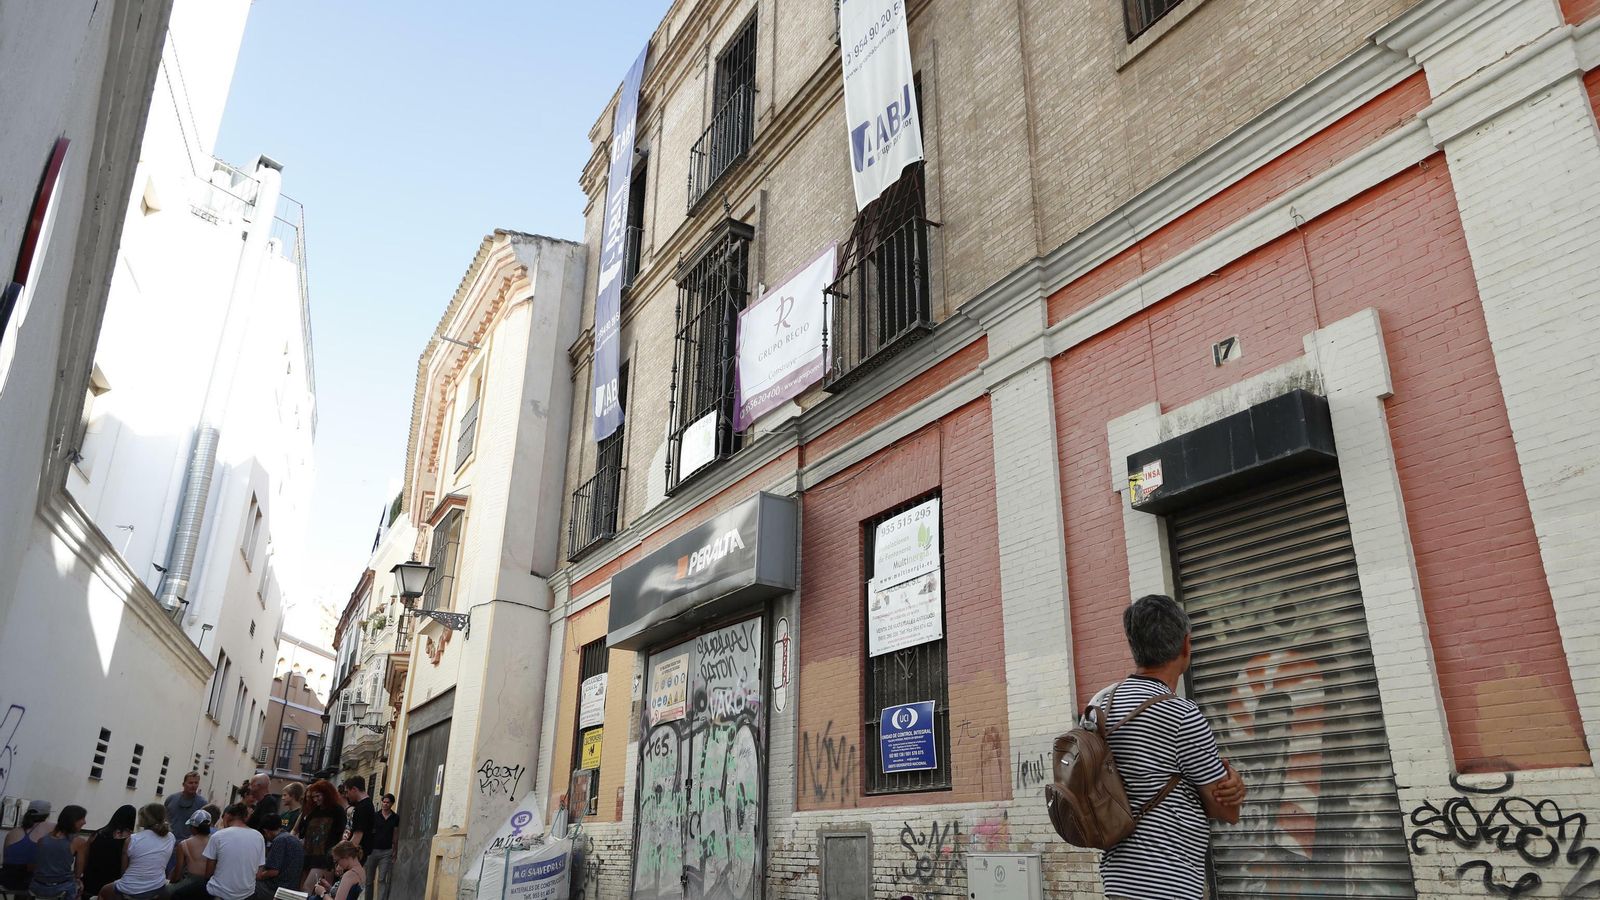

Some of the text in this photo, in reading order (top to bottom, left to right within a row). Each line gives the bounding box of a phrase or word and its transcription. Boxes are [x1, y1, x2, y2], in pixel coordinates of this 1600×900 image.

[854, 34, 868, 57] 954
[869, 22, 880, 40] 90
[881, 9, 892, 28] 20
[758, 322, 809, 362] GRUPO RECIO
[881, 506, 931, 537] 955 515 295
[688, 528, 745, 576] PERALTA
[900, 714, 909, 723] UCI
